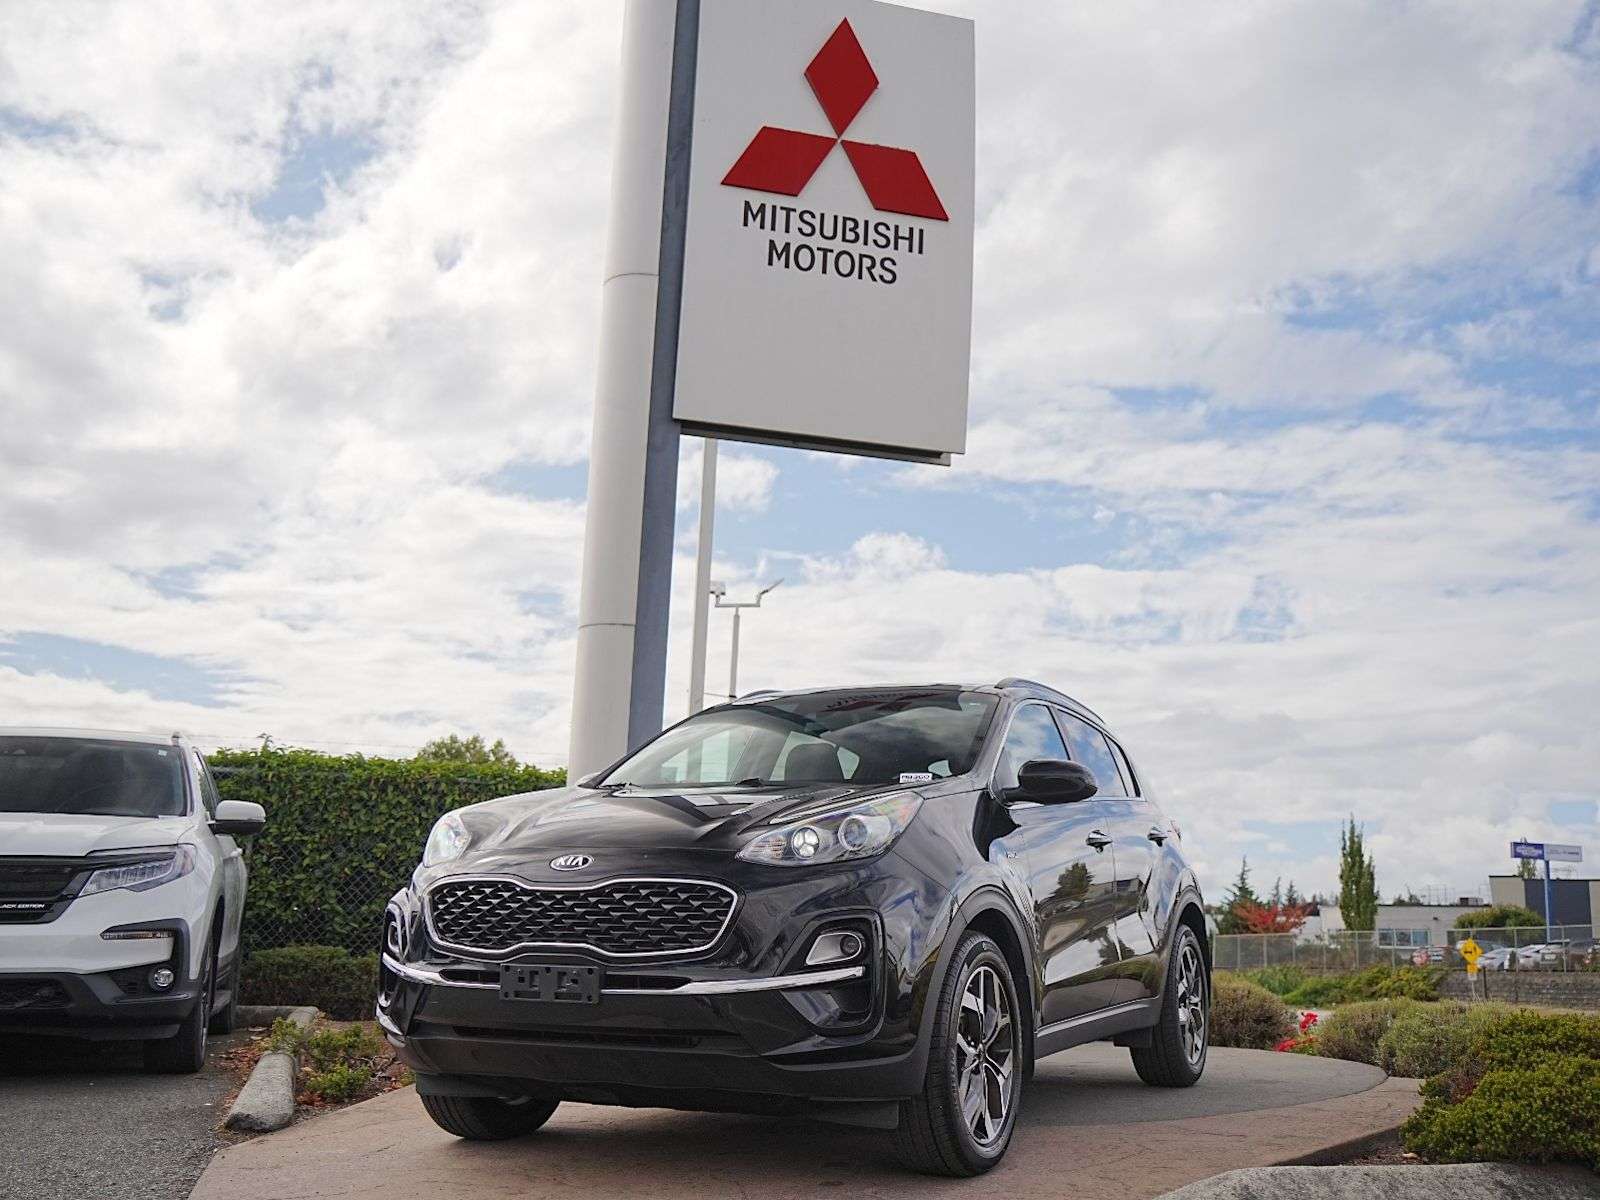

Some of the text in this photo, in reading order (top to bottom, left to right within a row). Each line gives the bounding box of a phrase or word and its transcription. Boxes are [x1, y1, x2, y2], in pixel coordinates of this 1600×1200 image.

[743, 200, 925, 254] MITSUBISHI
[767, 239, 897, 284] MOTORS
[555, 855, 584, 867] KIA
